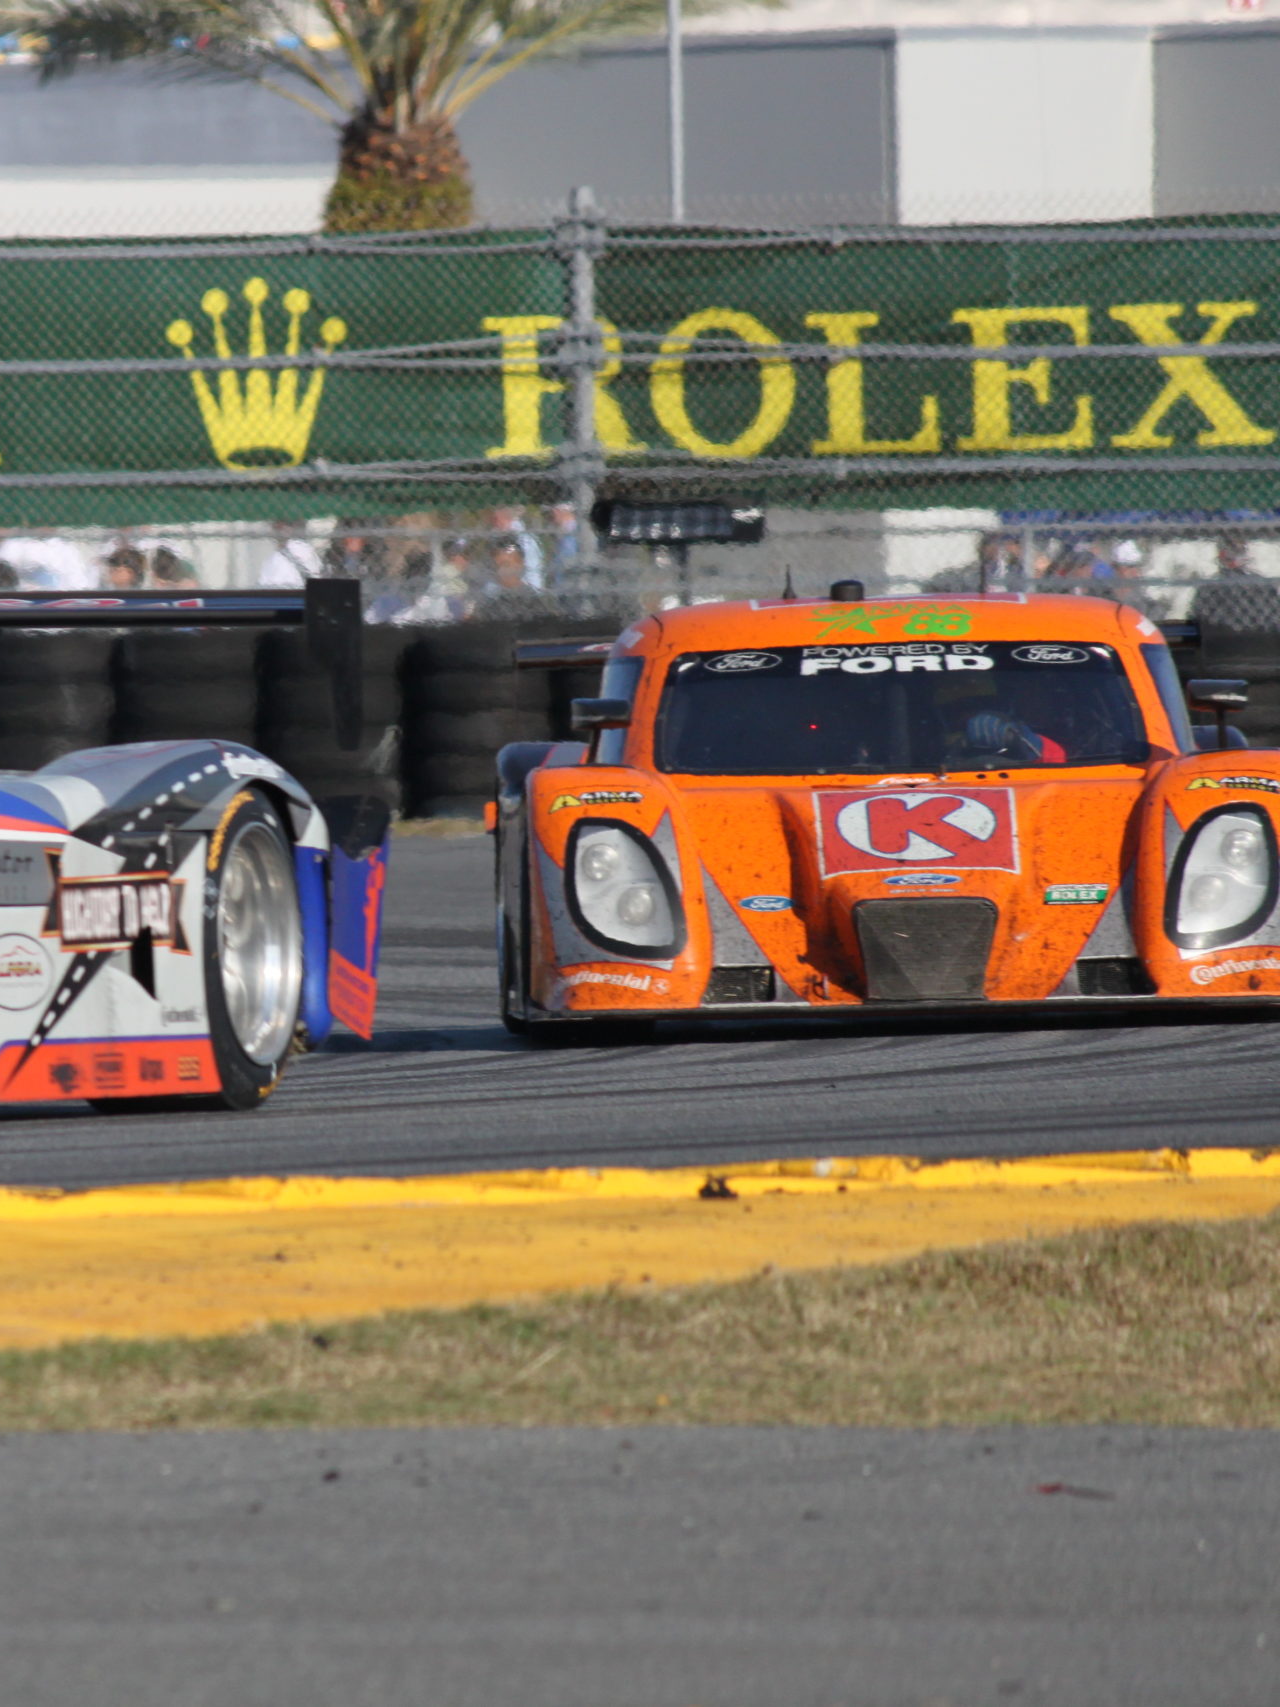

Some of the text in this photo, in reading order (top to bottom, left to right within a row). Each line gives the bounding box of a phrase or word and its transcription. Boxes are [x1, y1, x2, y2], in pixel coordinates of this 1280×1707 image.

[483, 301, 1275, 457] ROLEX
[903, 612, 972, 636] 88
[802, 643, 988, 657] POWERED BY
[800, 654, 995, 676] FORD
